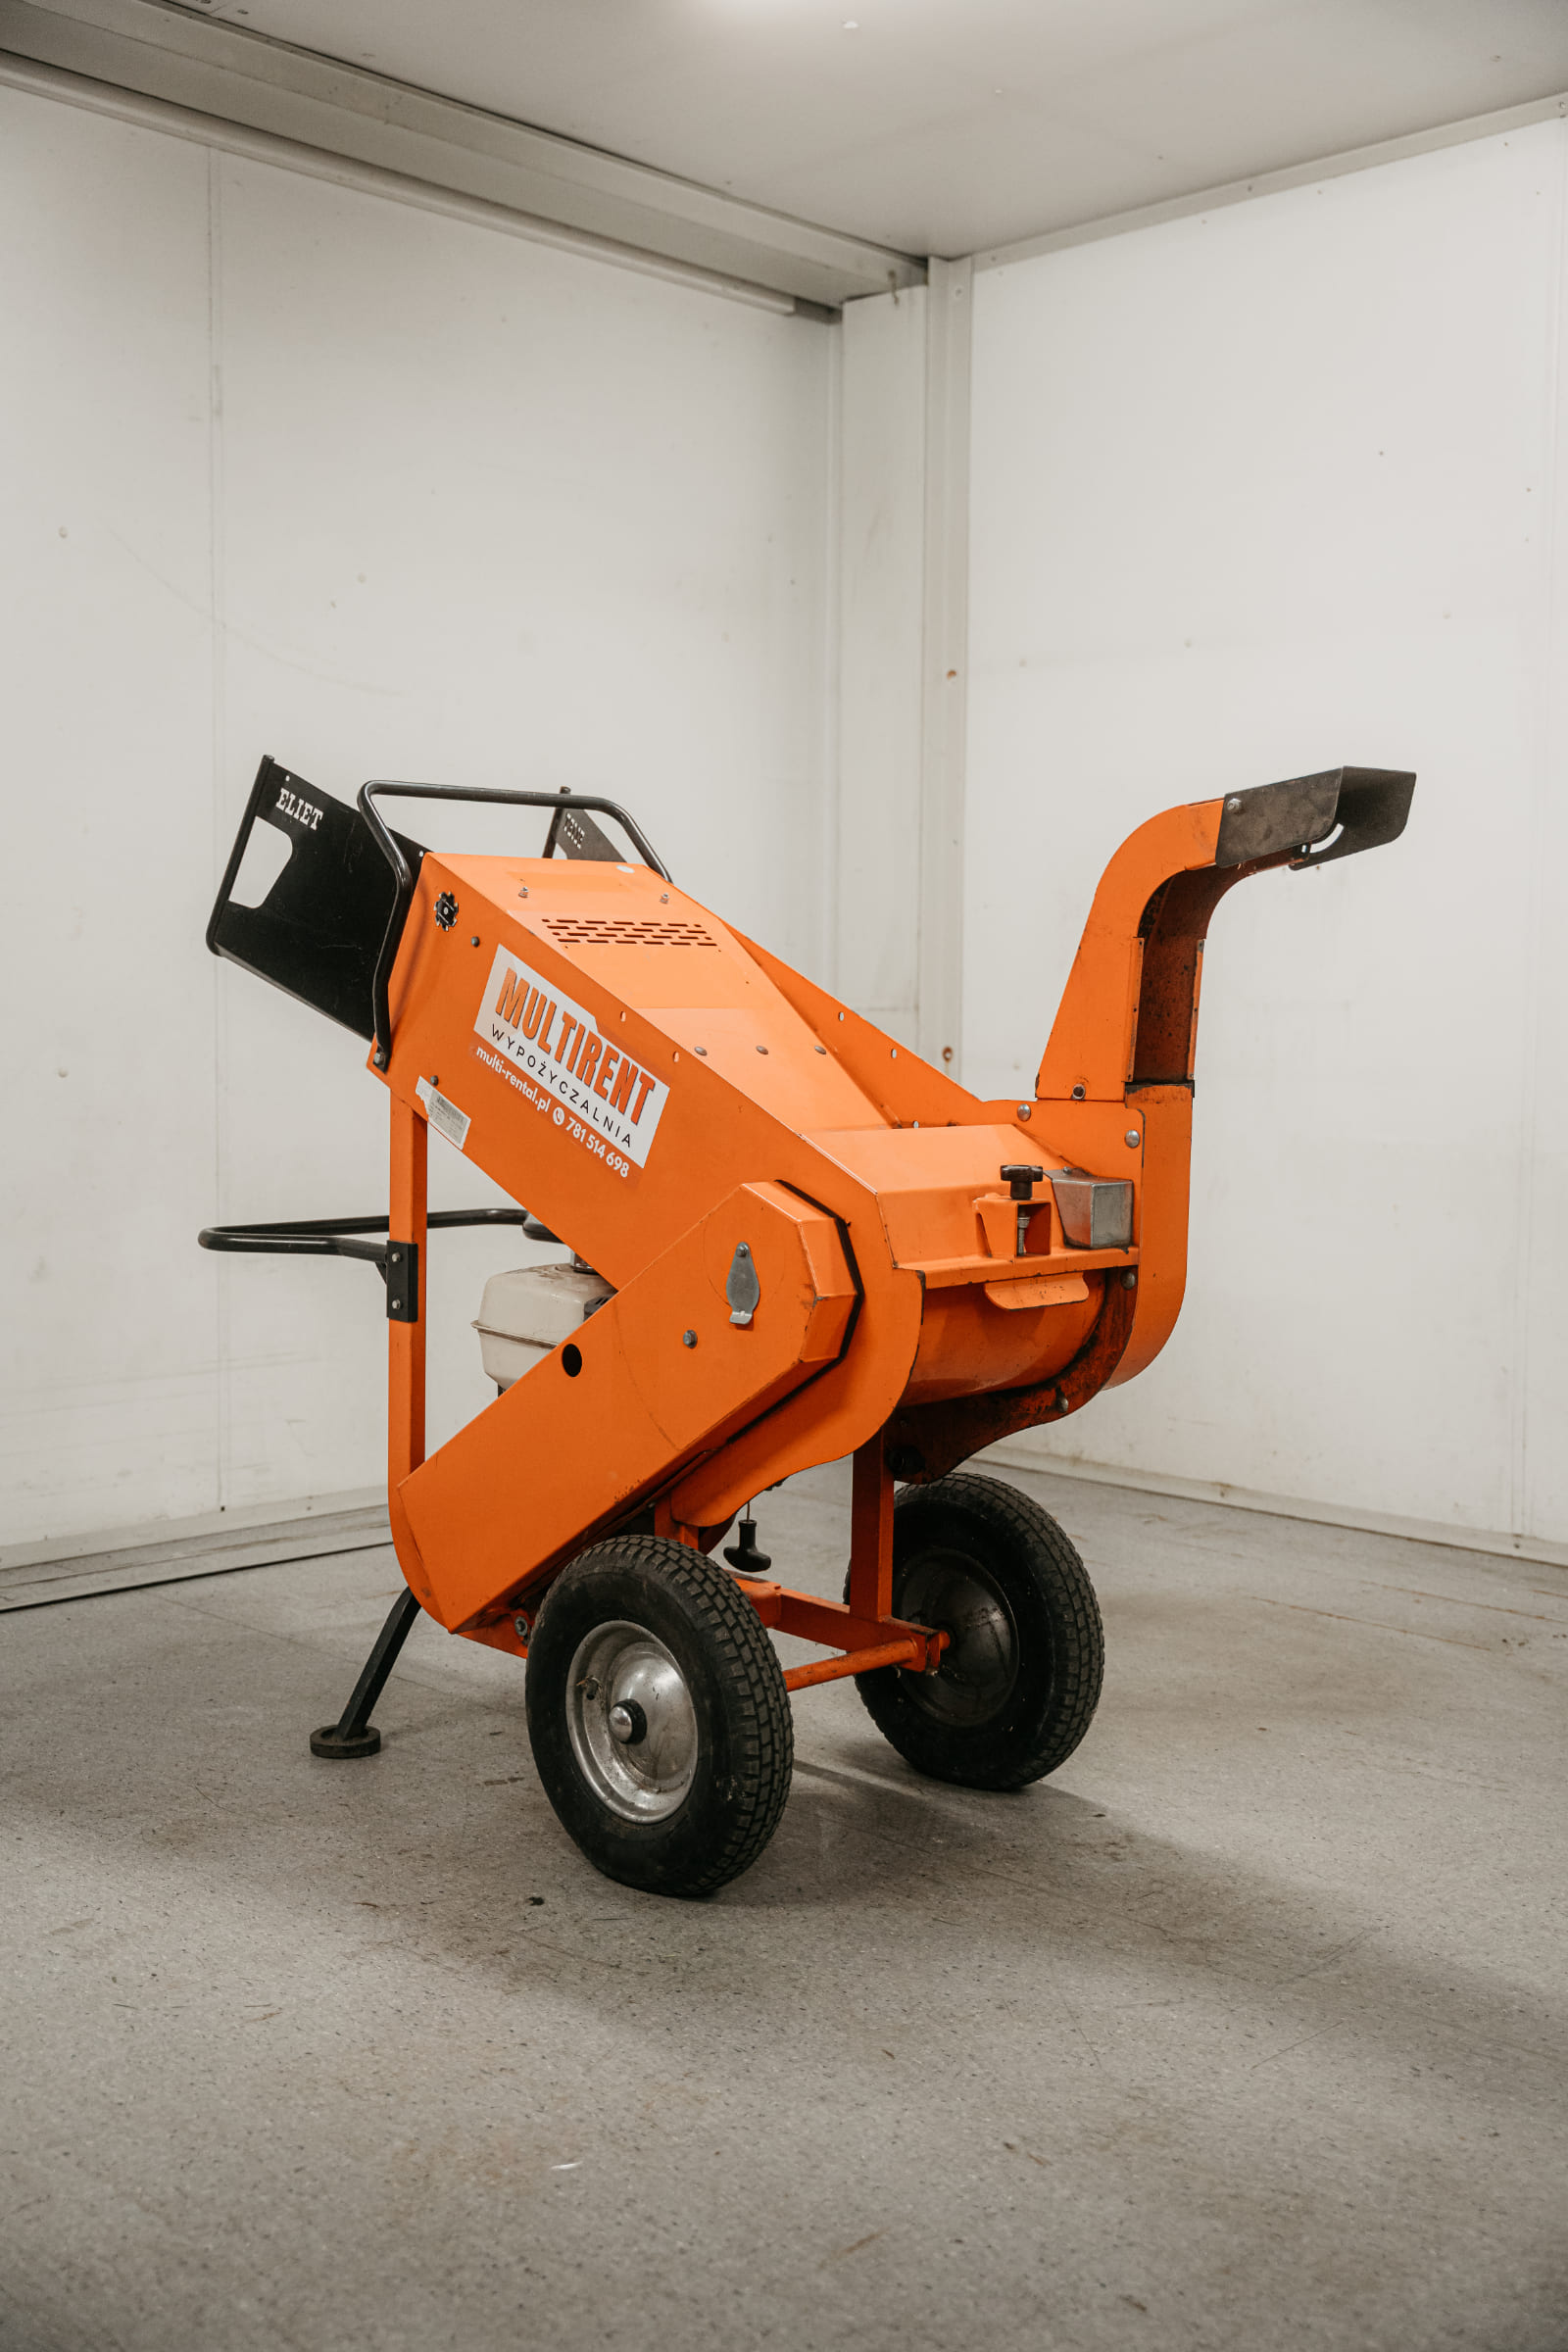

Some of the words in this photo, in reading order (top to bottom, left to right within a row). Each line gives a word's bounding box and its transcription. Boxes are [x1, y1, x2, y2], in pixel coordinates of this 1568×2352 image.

[275, 787, 323, 831] ELIET
[492, 1023, 631, 1148] WYPOŻYCZALNIA
[495, 966, 656, 1126] MULTIRENT
[476, 1046, 552, 1113] multi-rental.pl
[565, 1115, 587, 1143] 781
[586, 1133, 607, 1158] 514
[606, 1152, 630, 1178] 698
